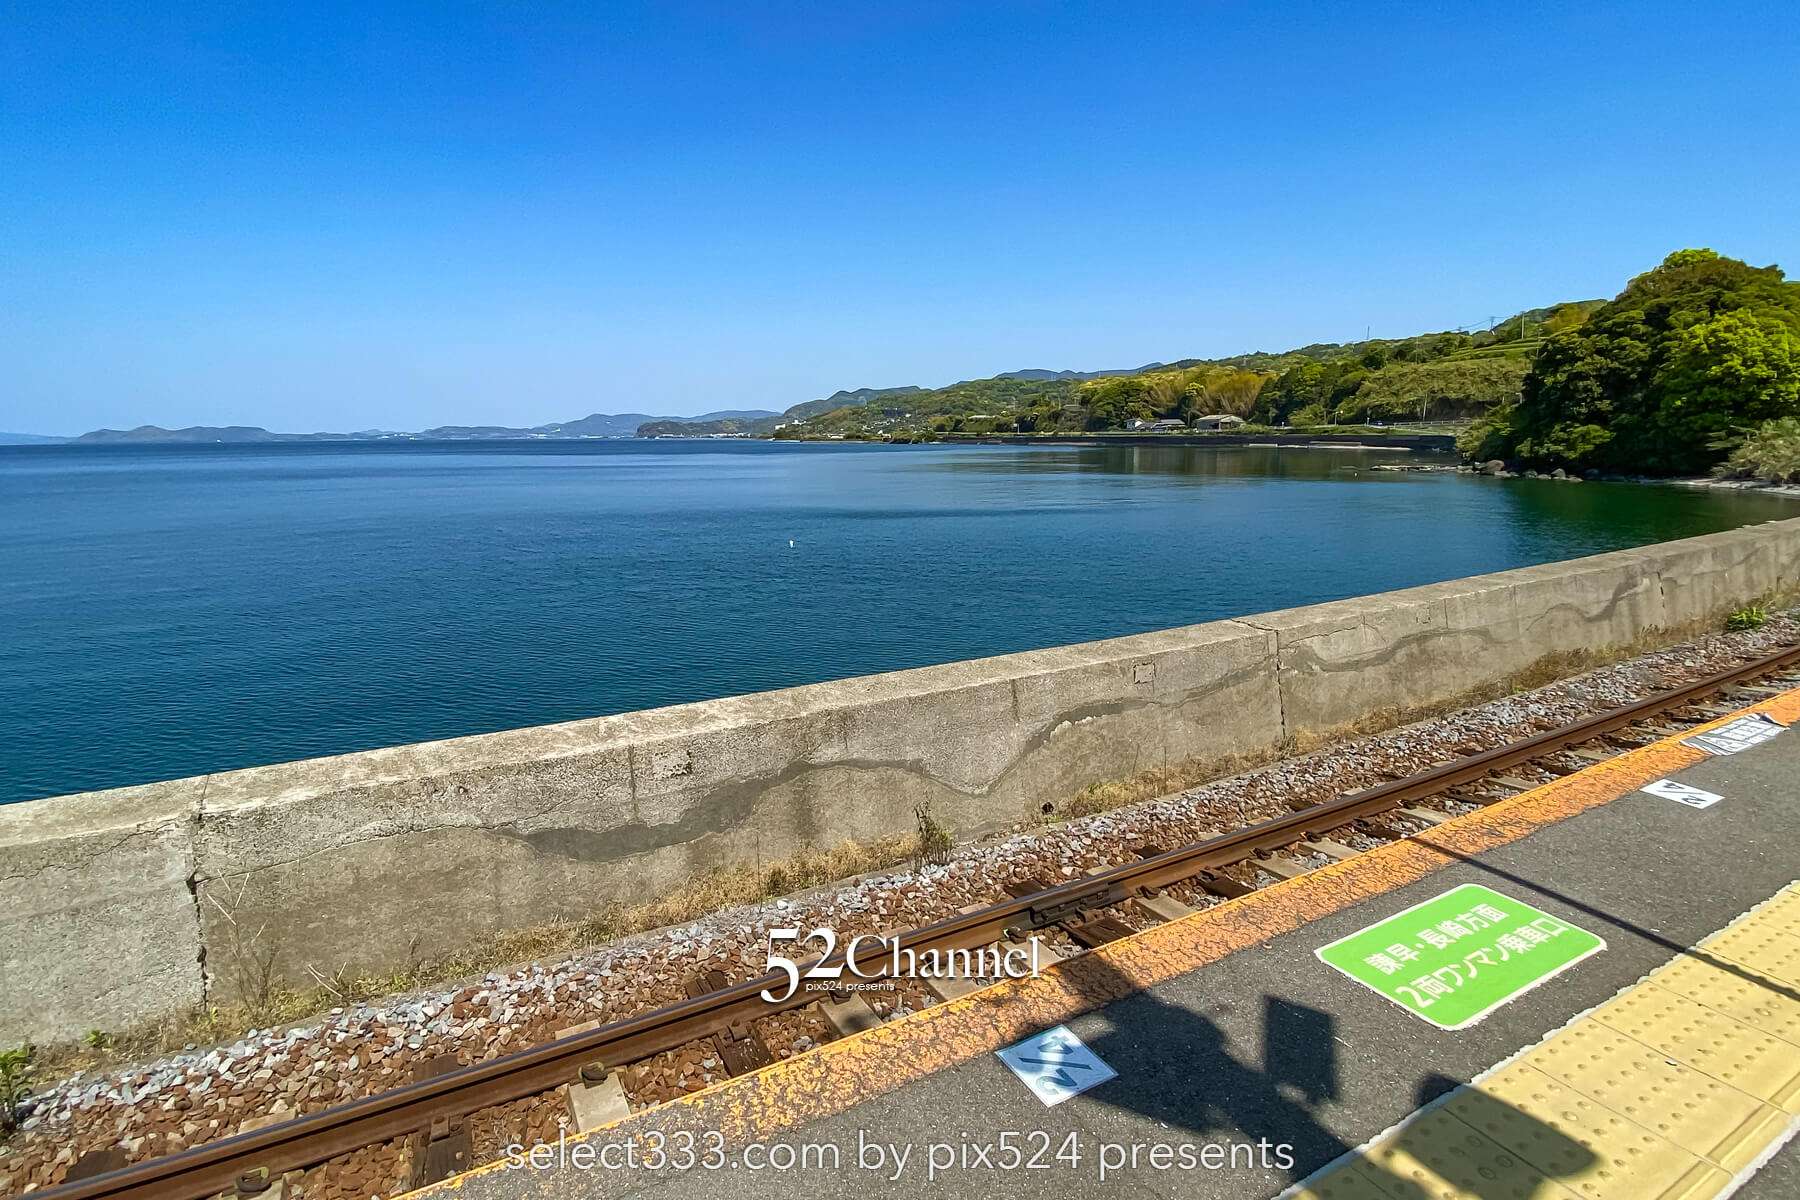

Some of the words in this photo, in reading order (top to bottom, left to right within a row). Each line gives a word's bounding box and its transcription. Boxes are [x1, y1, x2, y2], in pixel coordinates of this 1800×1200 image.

[1395, 917, 1571, 1008] 2両ワンマン乗車口
